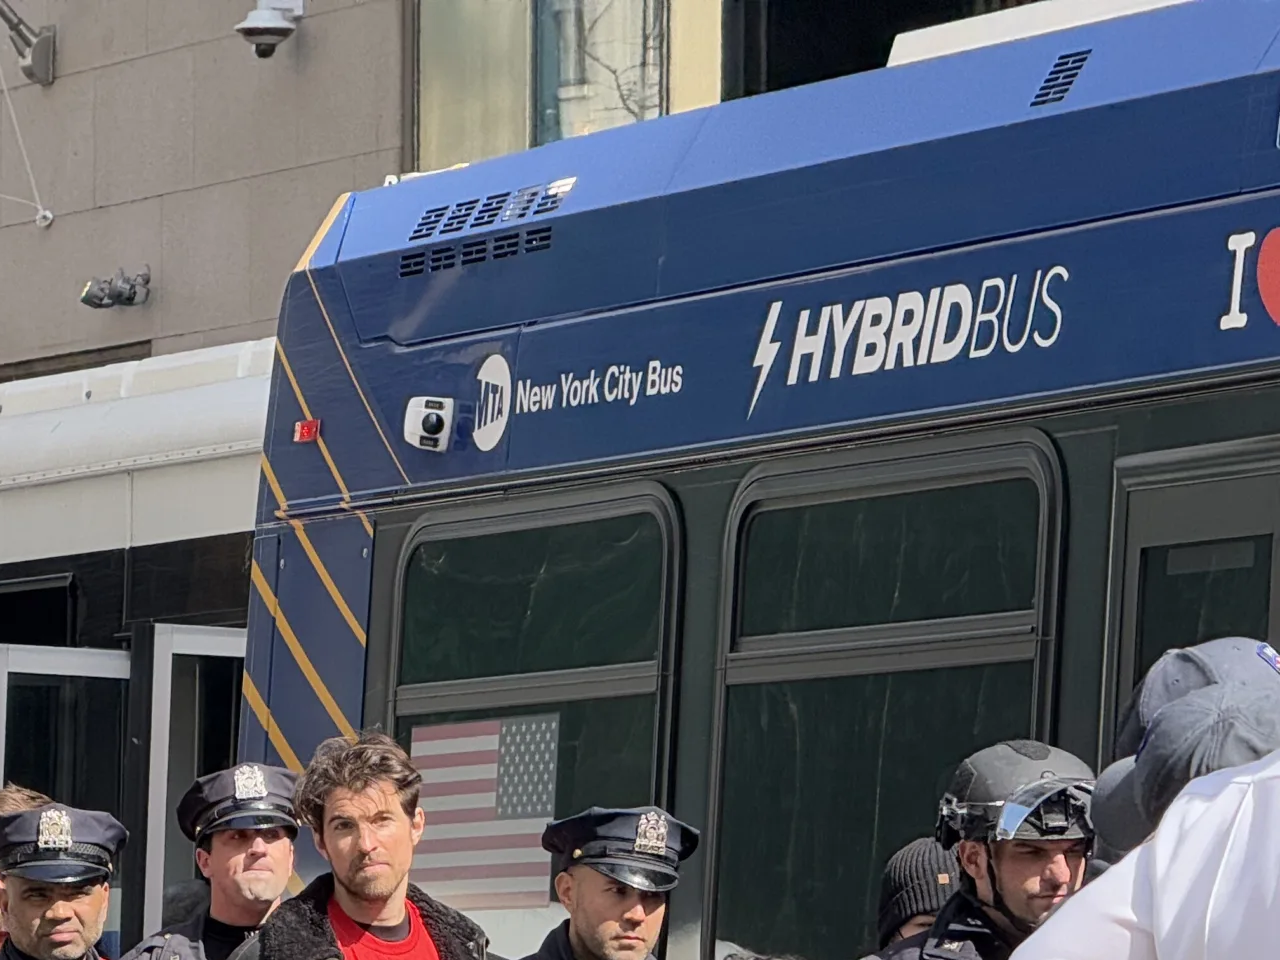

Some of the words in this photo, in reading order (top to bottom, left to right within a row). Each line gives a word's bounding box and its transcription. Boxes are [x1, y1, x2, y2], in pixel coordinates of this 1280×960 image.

[787, 265, 1069, 386] HYBRIDBUS
[1220, 231, 1255, 330] I
[516, 379, 556, 414] New
[560, 370, 600, 408] York
[604, 365, 643, 406] City
[646, 360, 683, 396] Bus
